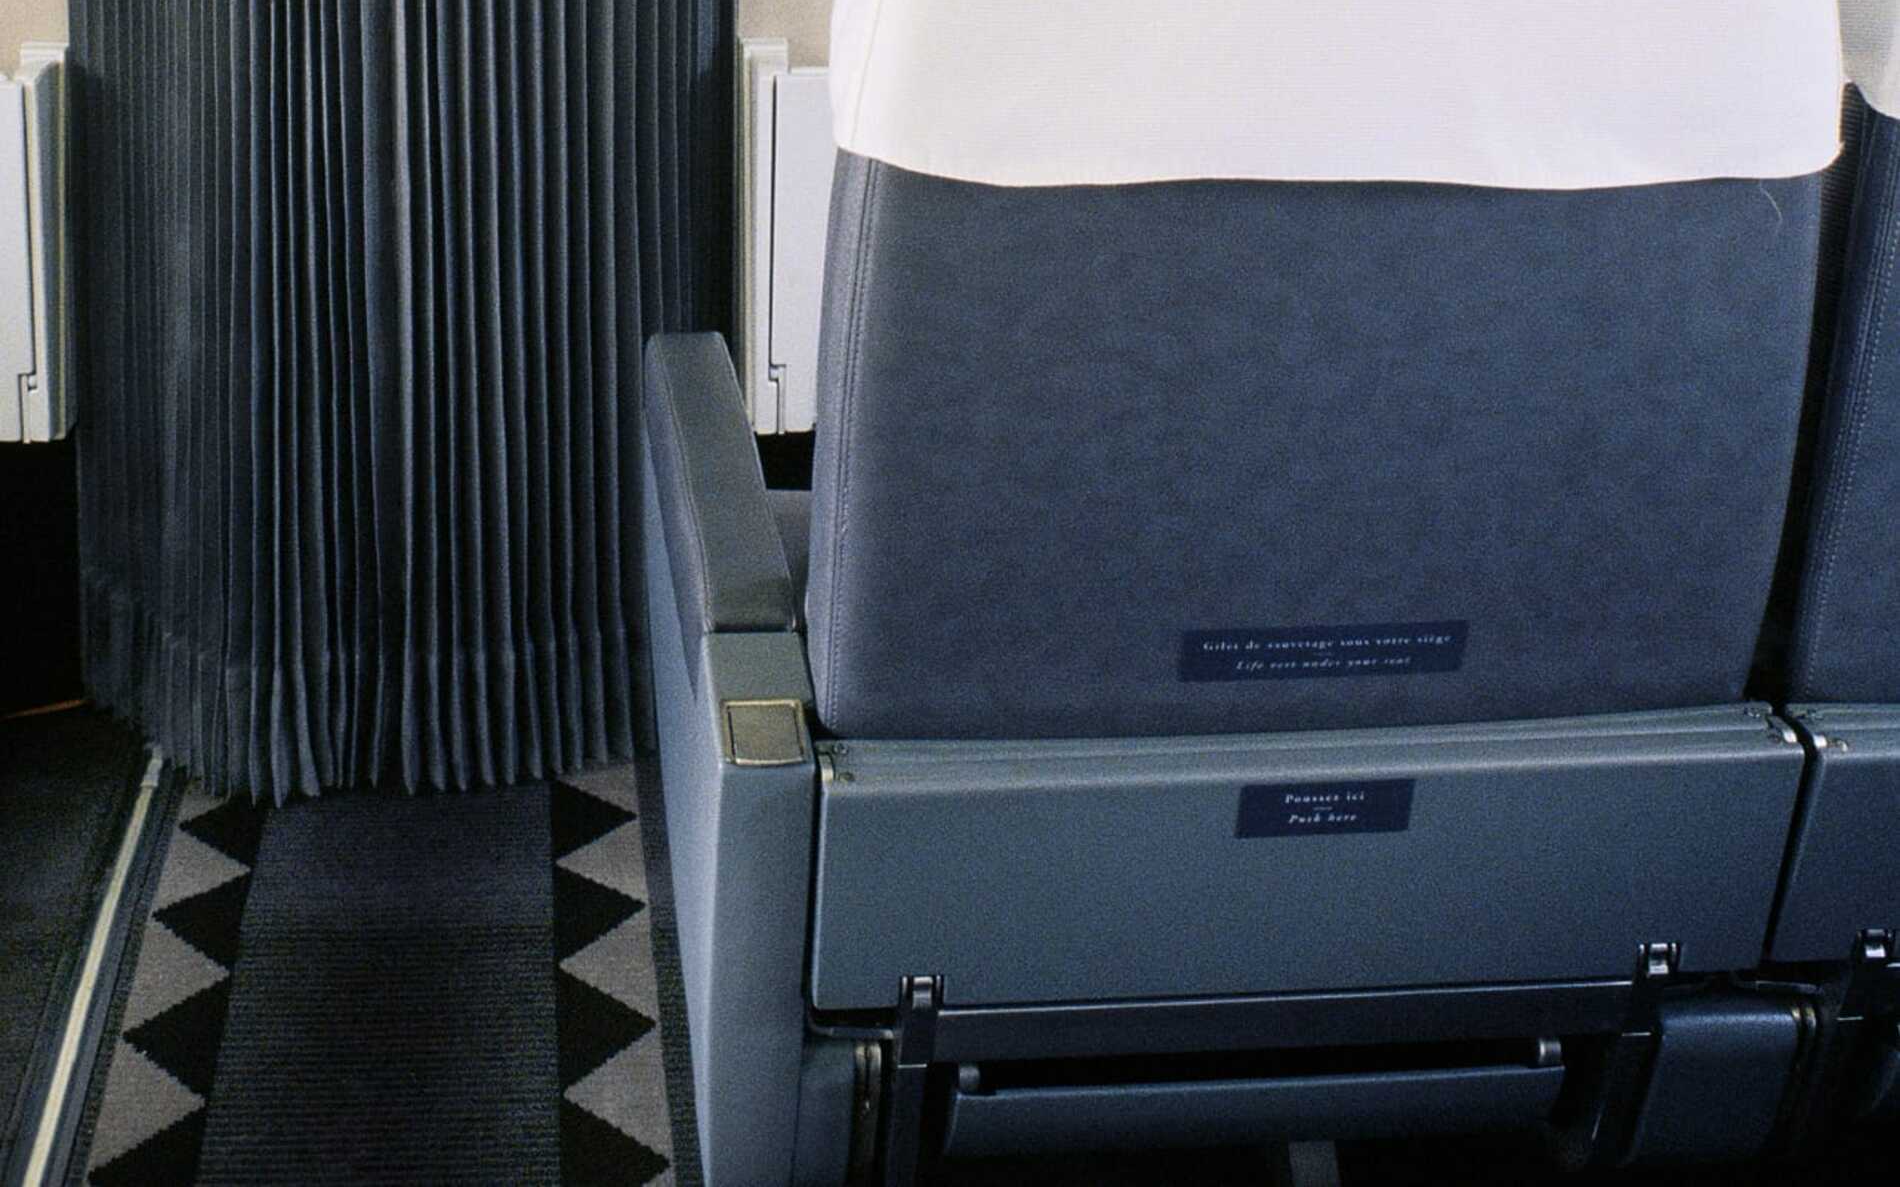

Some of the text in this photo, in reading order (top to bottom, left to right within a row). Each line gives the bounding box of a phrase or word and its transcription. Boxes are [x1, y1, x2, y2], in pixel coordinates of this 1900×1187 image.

[1245, 639, 1260, 649] de
[1376, 636, 1409, 646] votre
[1236, 656, 1411, 672] Life vest under your seat
[1346, 791, 1365, 802] ici
[1287, 812, 1357, 824] Push here
